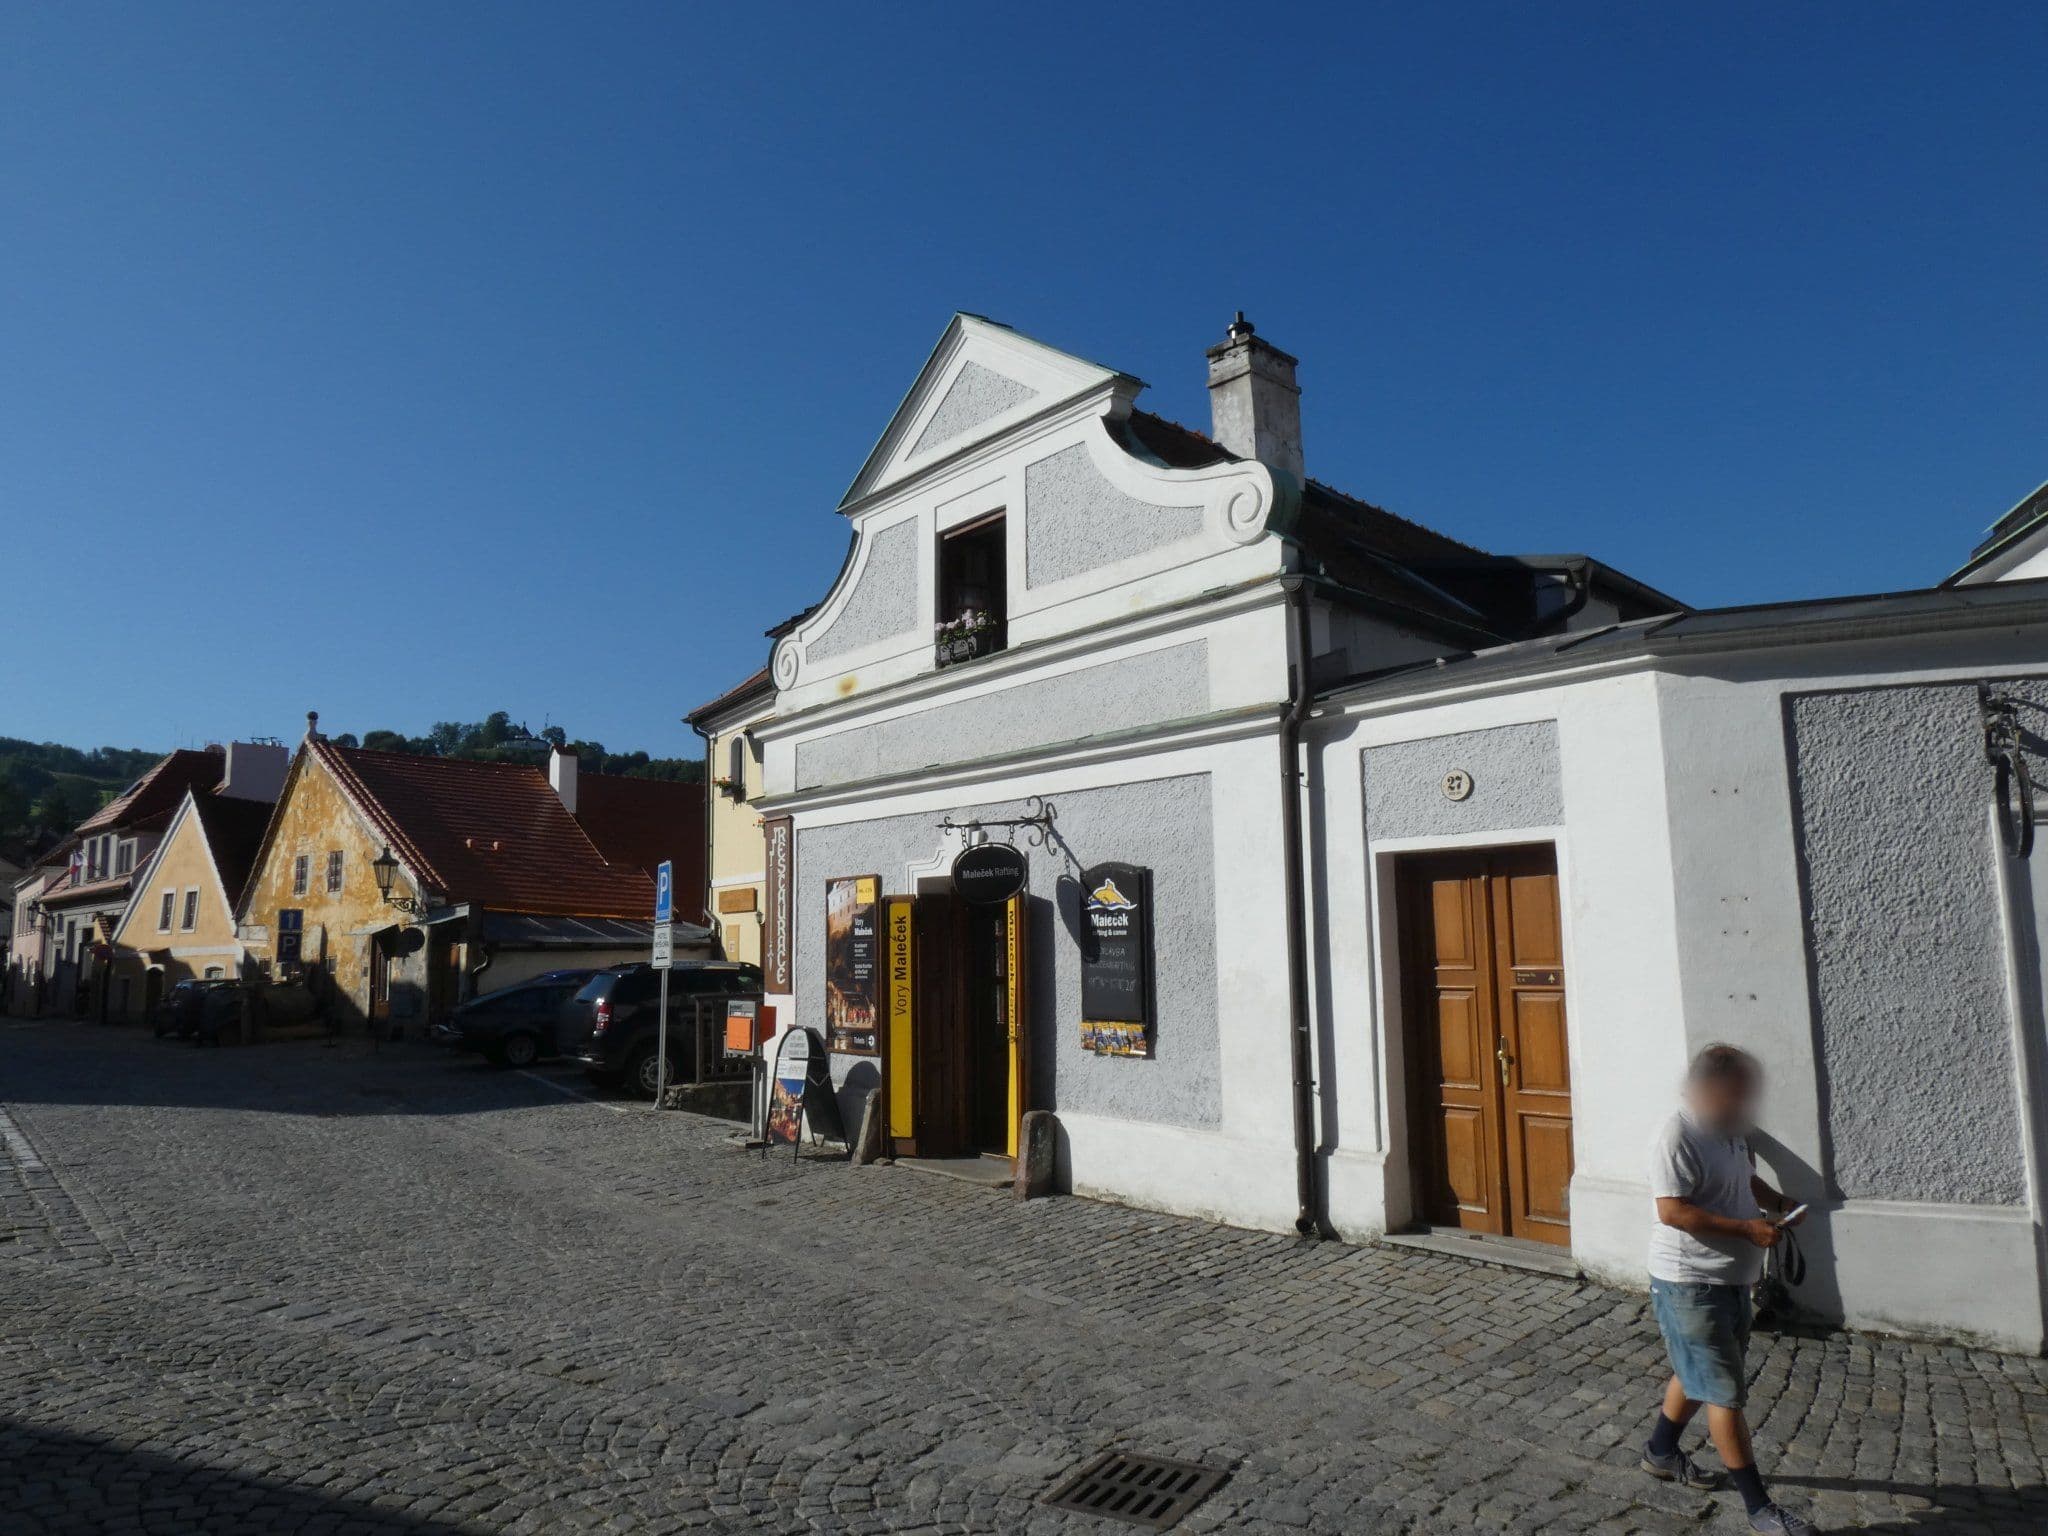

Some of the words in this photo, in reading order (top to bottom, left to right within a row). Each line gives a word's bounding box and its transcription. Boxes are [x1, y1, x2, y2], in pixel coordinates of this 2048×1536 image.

[660, 871, 669, 905] P
[282, 936, 297, 953] P
[892, 915, 907, 981] Maleček
[895, 984, 910, 1017] Vory
